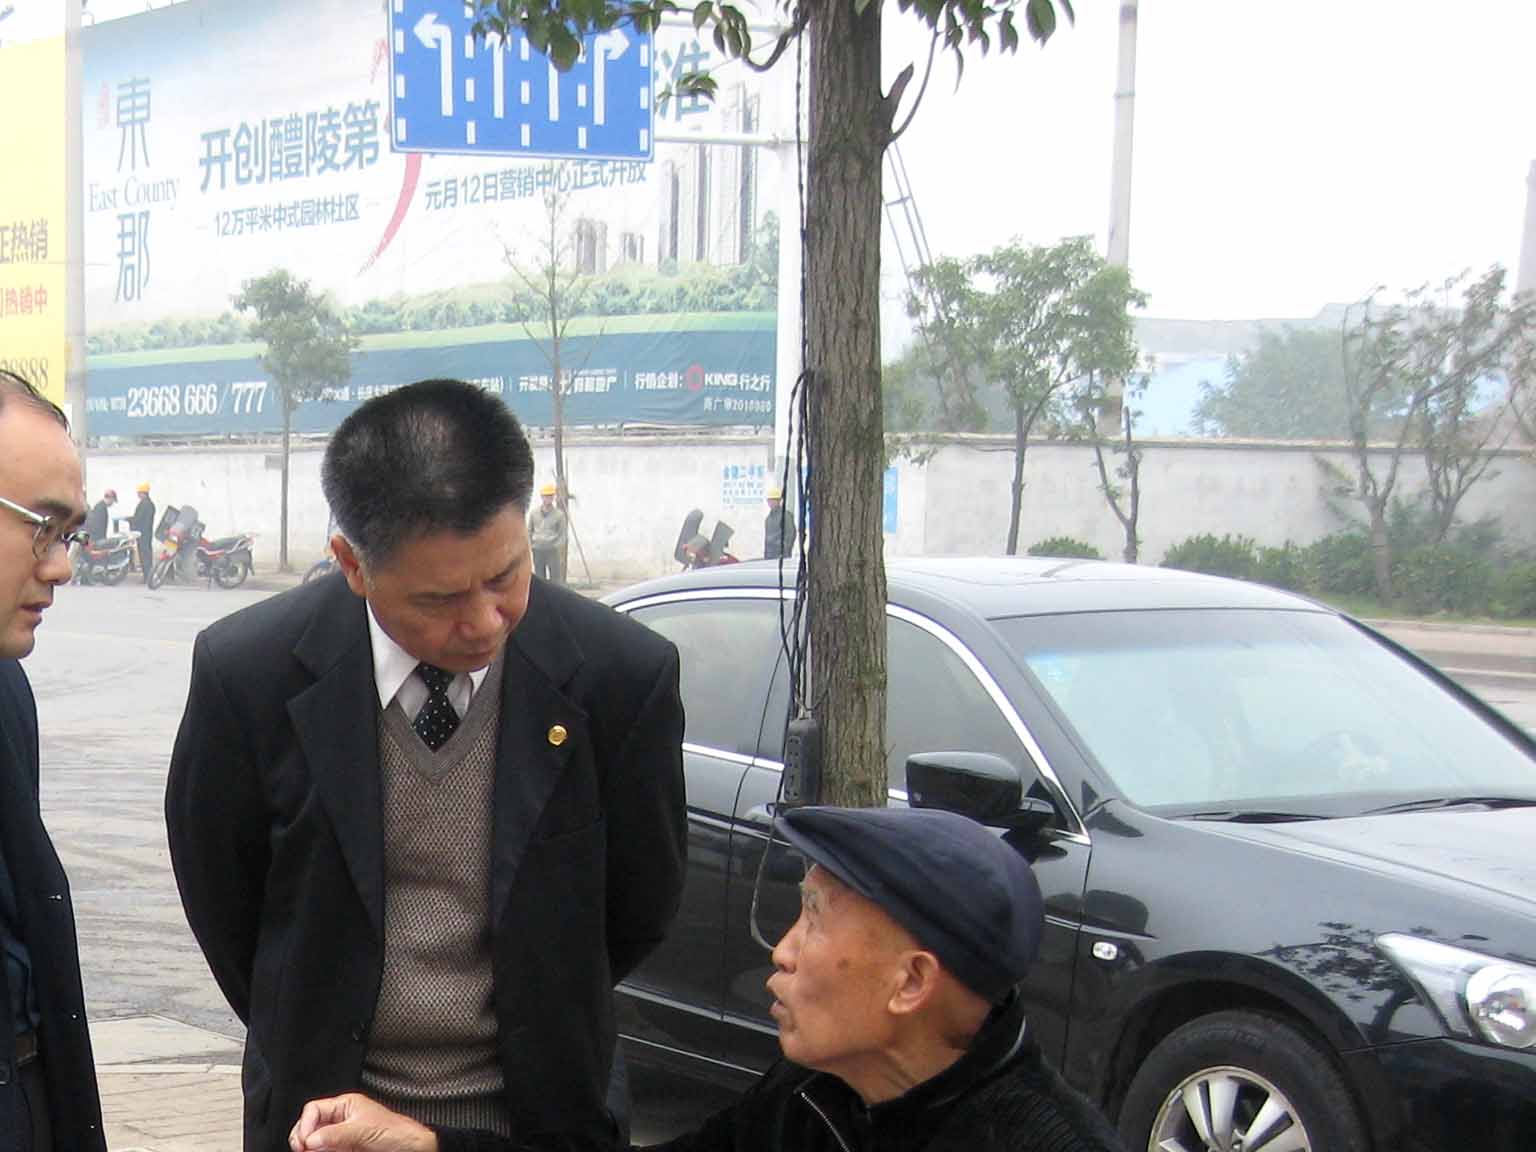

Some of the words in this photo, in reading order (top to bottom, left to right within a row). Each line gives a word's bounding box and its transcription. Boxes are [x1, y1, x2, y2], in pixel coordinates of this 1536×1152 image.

[199, 98, 382, 192] 开创醴陵第
[88, 182, 120, 213] East
[124, 176, 180, 211] County
[215, 193, 361, 238] 12万平米中式园林社区
[230, 381, 267, 414] 777
[704, 373, 738, 387] KING
